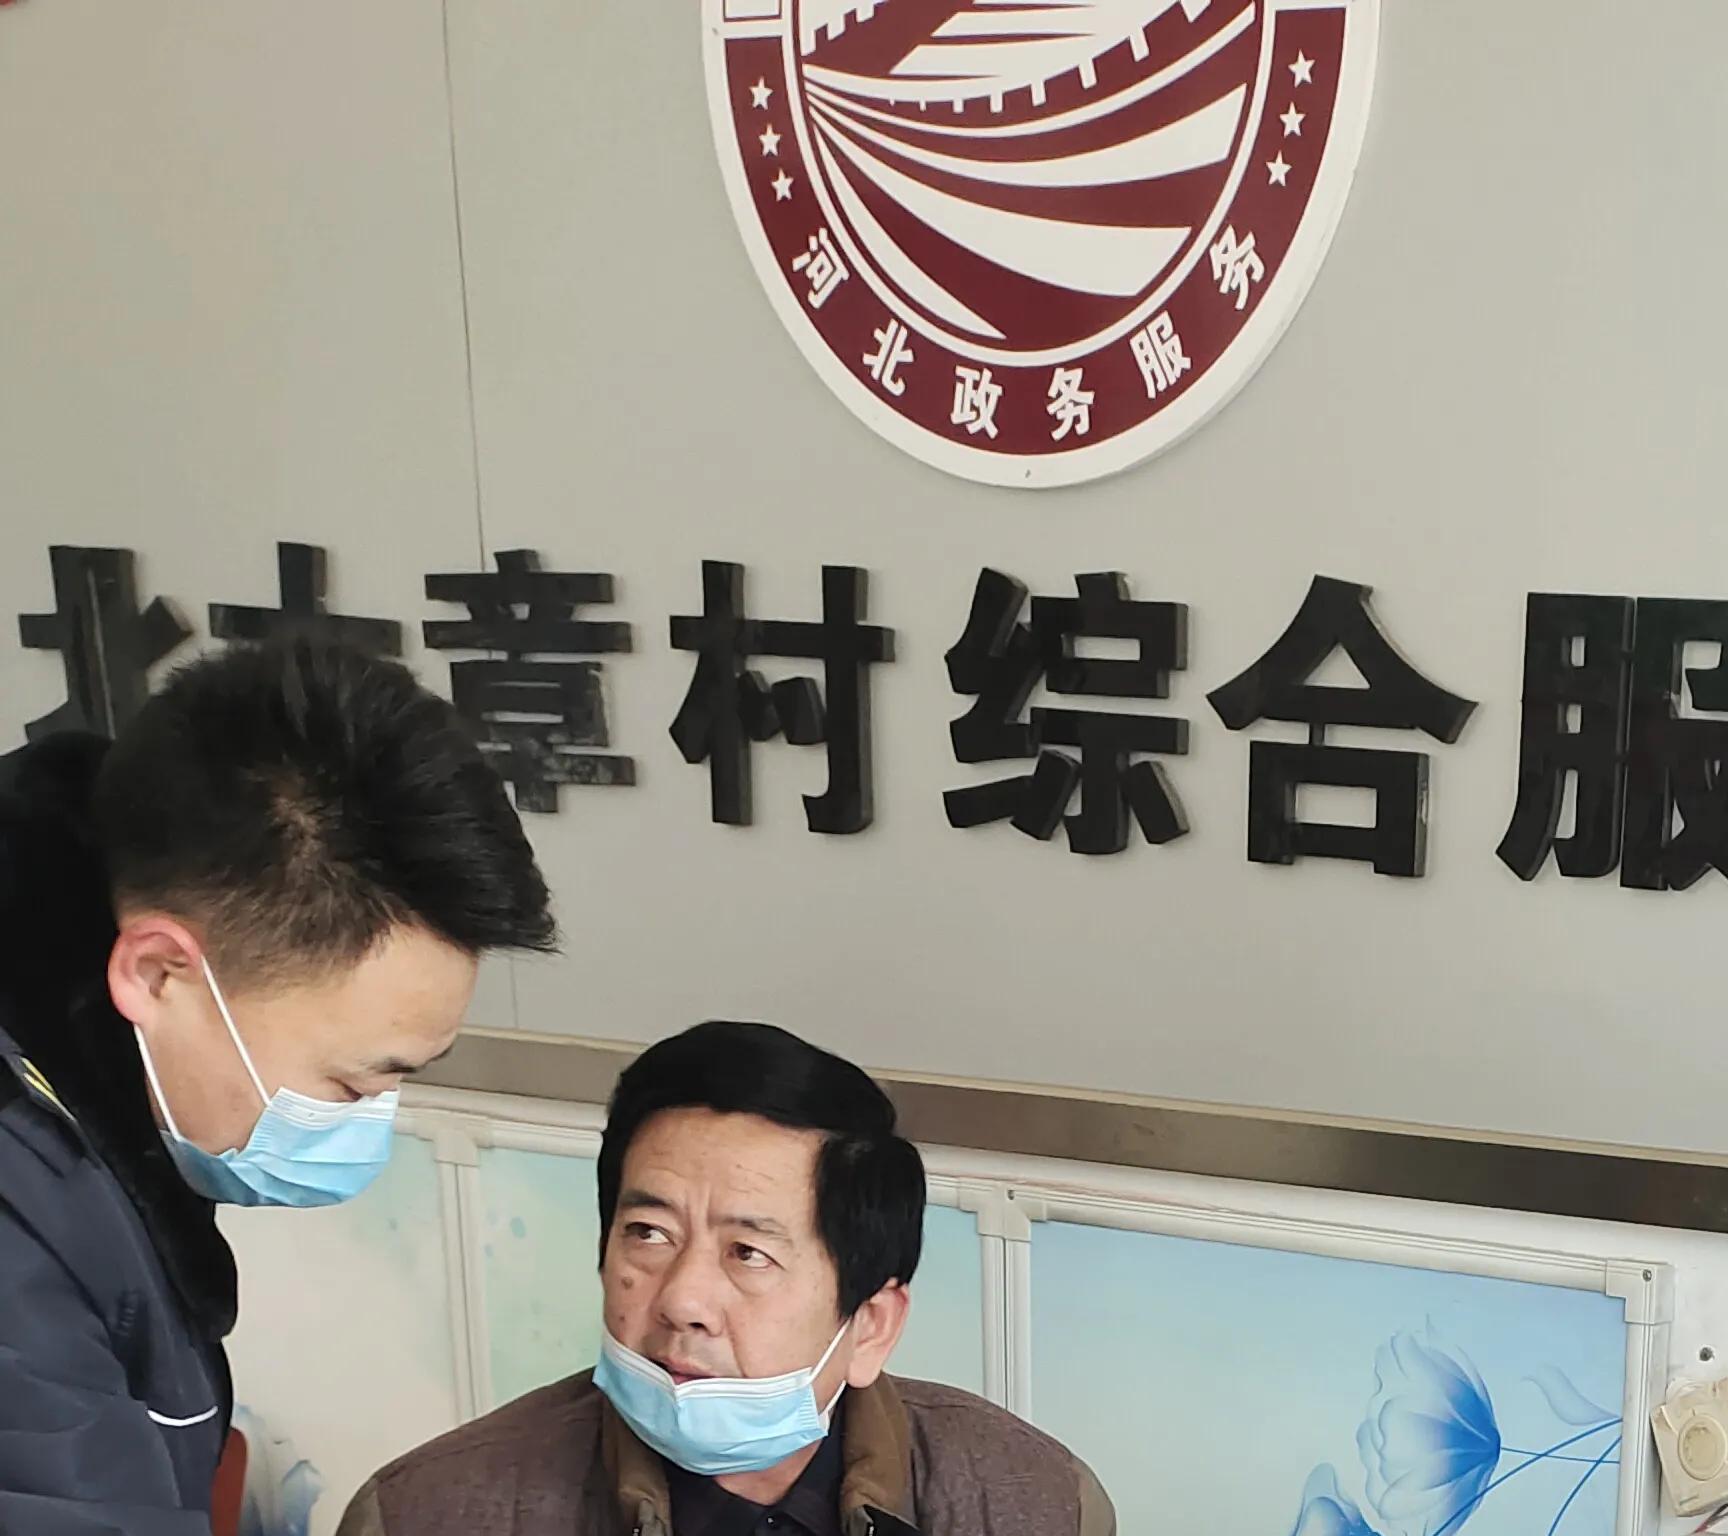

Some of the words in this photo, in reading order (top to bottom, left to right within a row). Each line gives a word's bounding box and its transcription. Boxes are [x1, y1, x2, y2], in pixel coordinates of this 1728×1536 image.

[793, 226, 1266, 443] 河北政务服务
